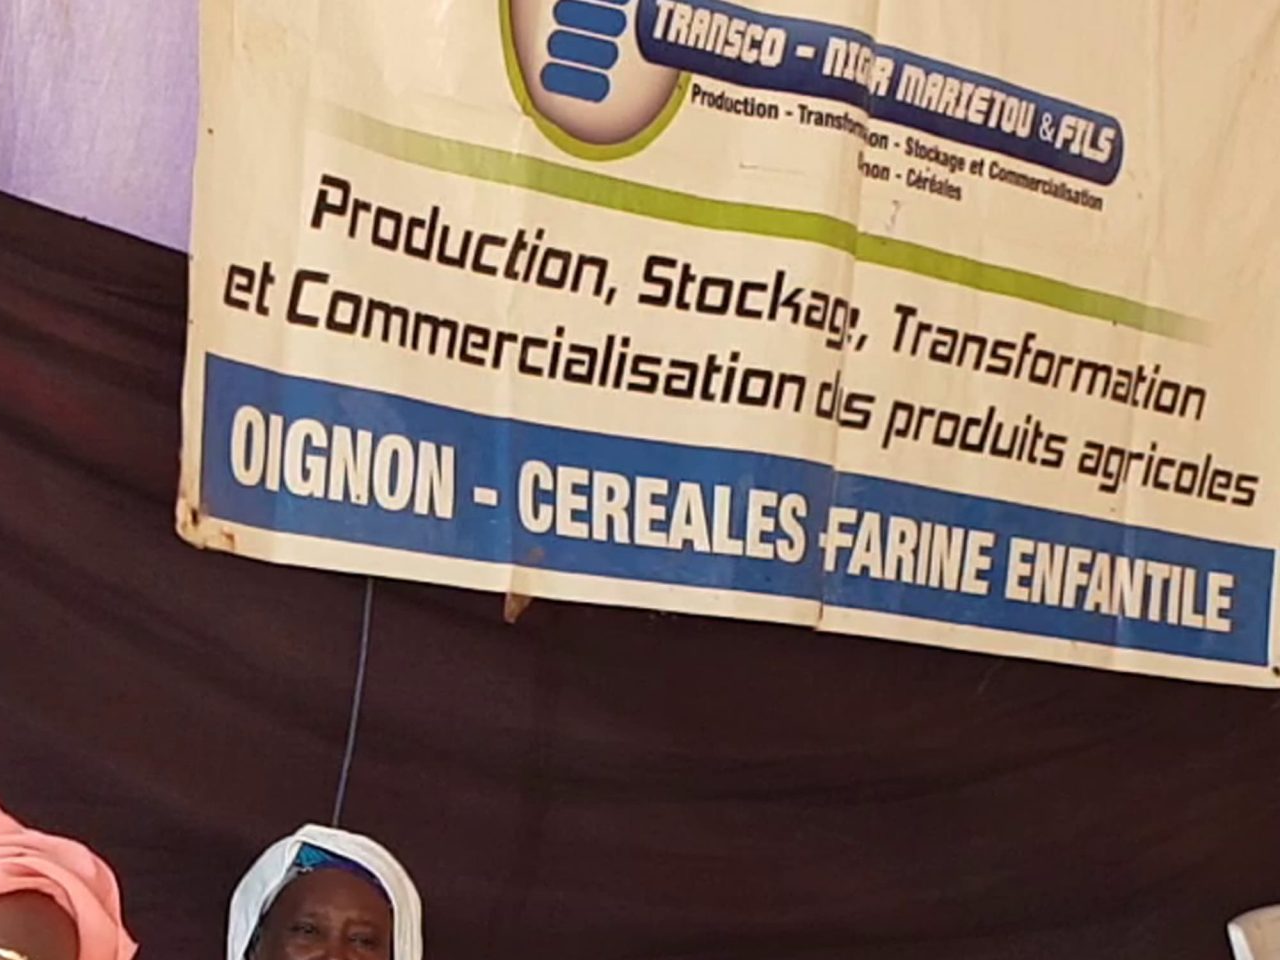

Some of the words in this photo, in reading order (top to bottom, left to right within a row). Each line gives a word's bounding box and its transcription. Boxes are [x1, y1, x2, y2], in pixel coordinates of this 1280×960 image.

[653, 2, 787, 67] TRANSCO
[822, 37, 895, 96] NIGR
[896, 63, 1035, 138] MARIETOU
[1055, 115, 1116, 163] FILS
[692, 83, 778, 119] Production
[905, 137, 967, 174] Stockage
[969, 156, 984, 177] et
[988, 161, 1103, 211] Commercialisation
[223, 261, 276, 317] et
[286, 268, 806, 414] Commercialisation
[882, 400, 1068, 469] produits
[1077, 439, 1260, 507] agricoles
[310, 173, 617, 306] Production,
[892, 304, 1207, 421] Transformation
[230, 404, 457, 520] OIGNON
[519, 459, 809, 564] CEREALES
[824, 506, 997, 596] FARINE
[1004, 537, 1235, 633] ENFANTILE
